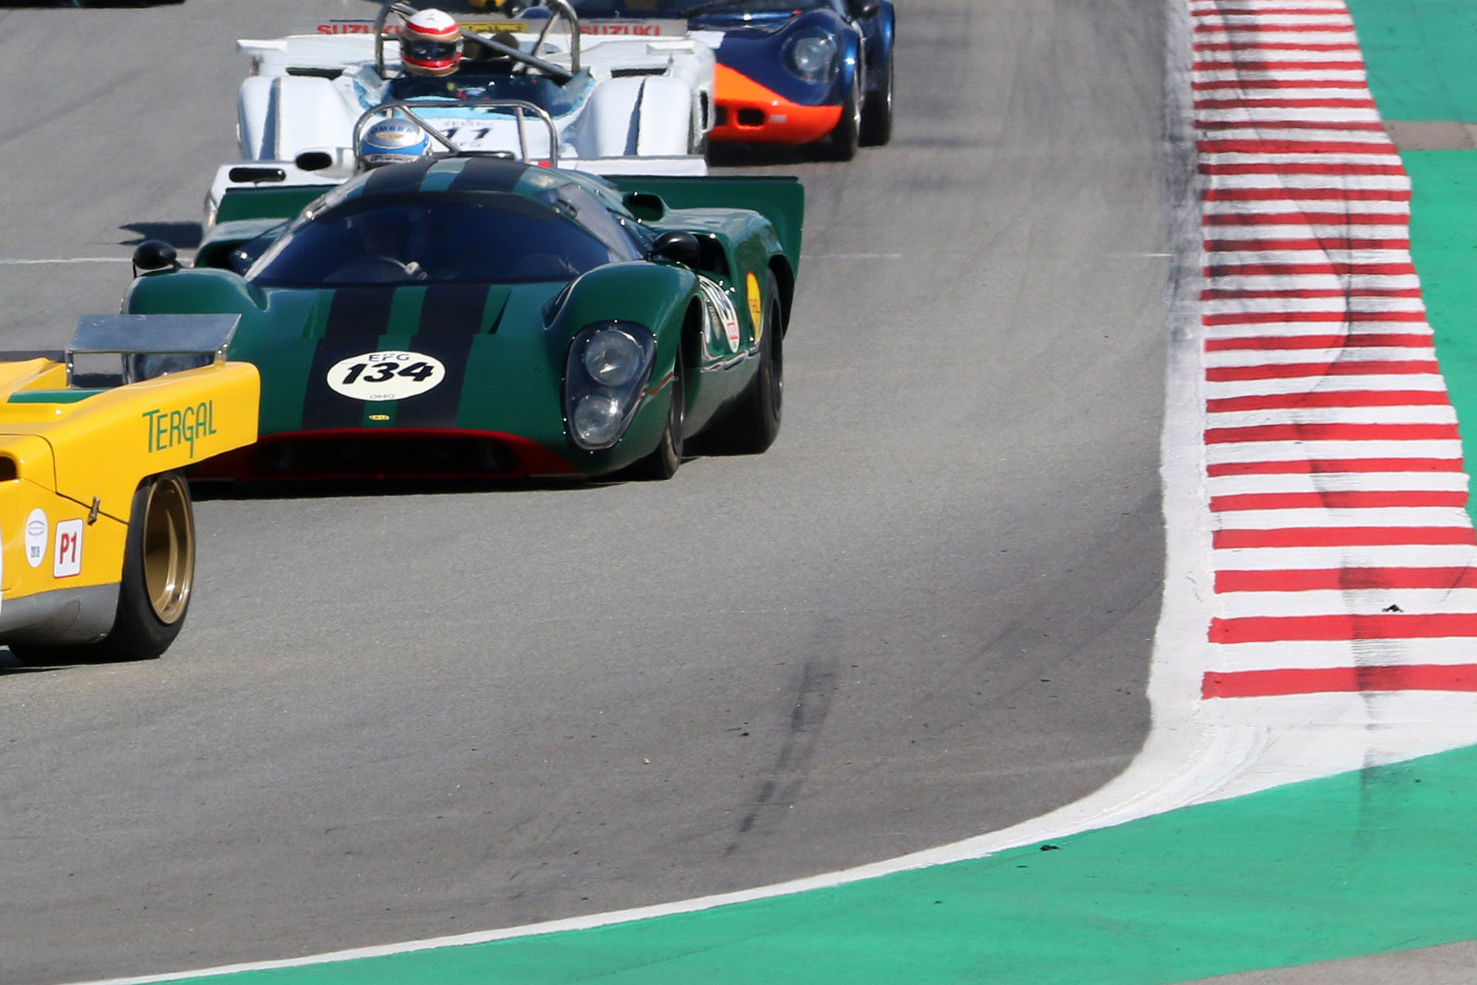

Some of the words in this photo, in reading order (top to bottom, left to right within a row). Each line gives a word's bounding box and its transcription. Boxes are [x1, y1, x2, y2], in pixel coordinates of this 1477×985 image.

[368, 353, 411, 361] EFG
[341, 361, 435, 385] 134
[141, 399, 218, 459] TERGAL
[59, 530, 78, 565] P1
